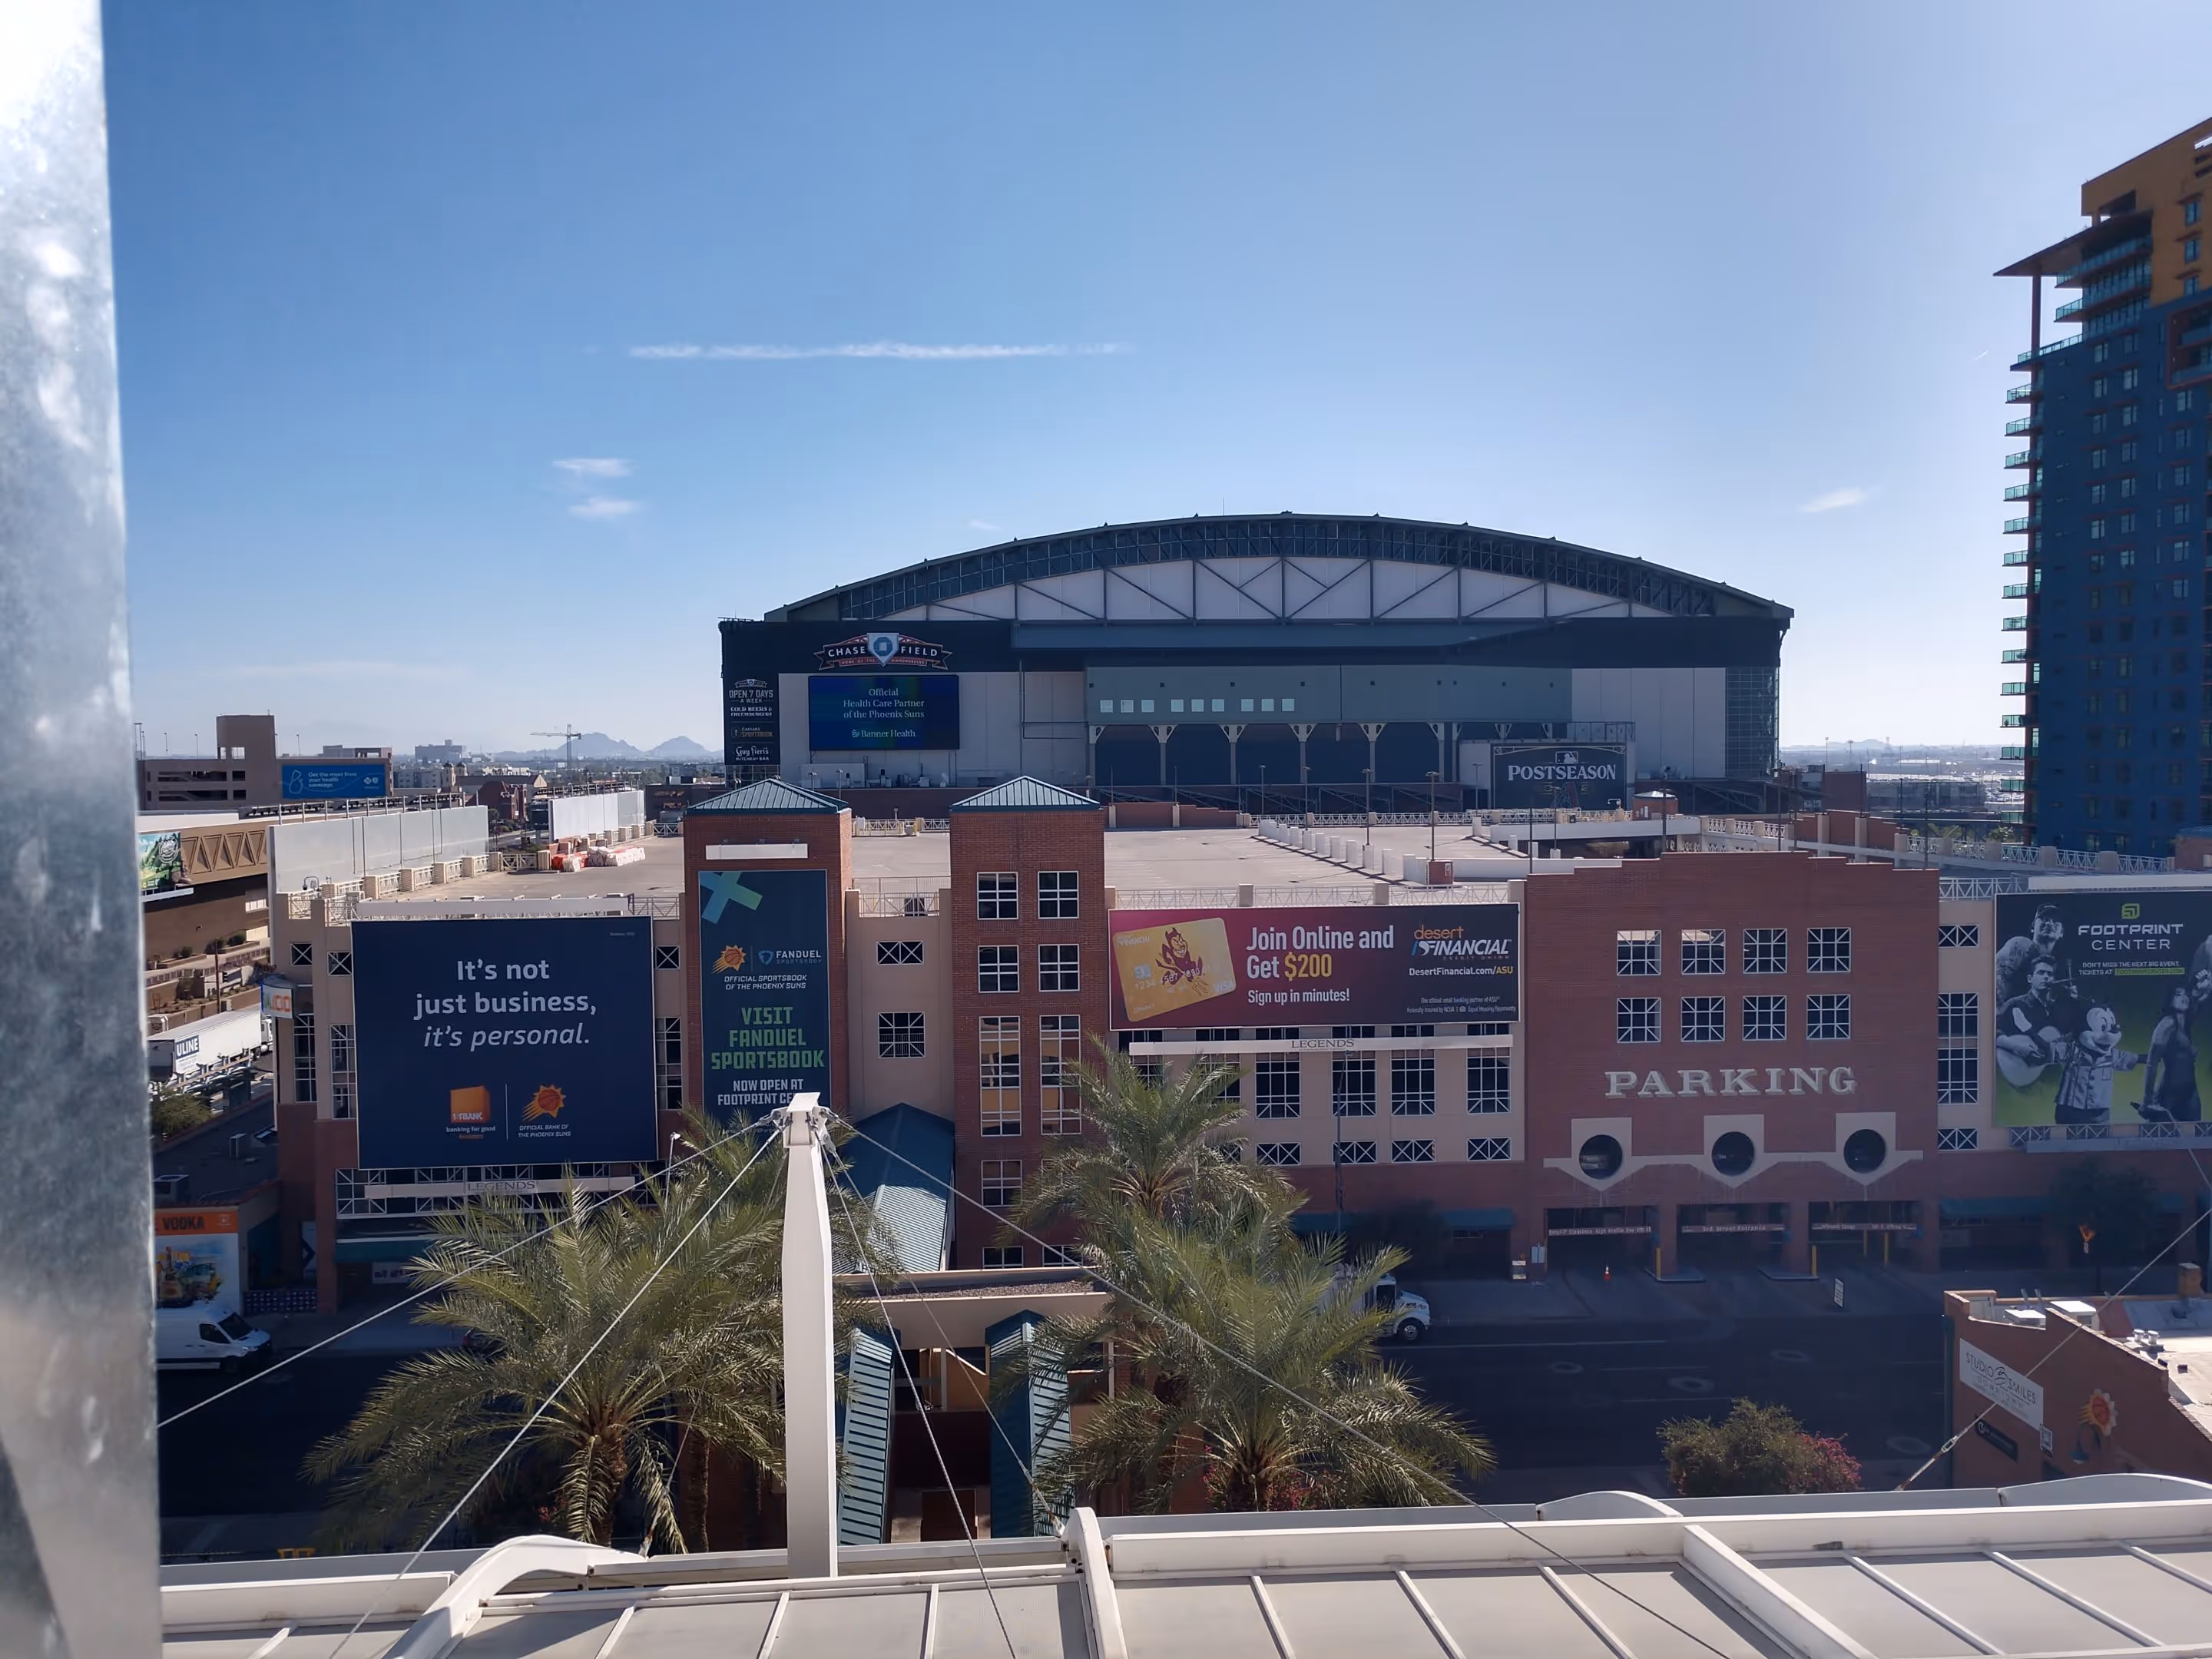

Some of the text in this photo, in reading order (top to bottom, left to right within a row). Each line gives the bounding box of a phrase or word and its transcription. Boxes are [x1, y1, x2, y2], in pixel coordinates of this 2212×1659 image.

[828, 646, 938, 657] CHASE FIELD
[729, 690, 747, 698] OPEN
[756, 690, 773, 698] DAYS
[843, 699, 871, 707] Health
[873, 699, 892, 707] Care
[843, 710, 925, 718] of the Phoenix Suns
[1508, 764, 1616, 781] POSTSEASON
[1413, 925, 1464, 940] desert
[2078, 923, 2184, 935] FOOTPRINT
[1246, 925, 1394, 951] Join Online and
[2091, 939, 2171, 951] CENTER
[776, 950, 822, 959] FANDUEL
[507, 960, 550, 980] not
[1247, 955, 1280, 979] Get
[1284, 952, 1333, 982] $200
[1409, 966, 1514, 976] DesertFinancial.com/ASU
[1248, 988, 1350, 1006] Sign up in minutes!
[413, 991, 597, 1021] just business,
[741, 1006, 793, 1025] VISIT
[470, 1023, 591, 1052] personal.
[730, 1028, 806, 1048] FANDUEL
[1292, 1039, 1355, 1048] LEGENDS
[176, 1038, 199, 1058] ULINE
[711, 1049, 825, 1070] SPORTSBOOK
[733, 1078, 804, 1091] NOW OPEN AT
[1604, 1066, 1856, 1098] PARKING
[717, 1094, 777, 1106] FOOTPRINT
[468, 1181, 535, 1191] LEGENDS
[161, 1217, 206, 1230] VODKA
[1966, 1352, 1995, 1378] STUDIO
[2008, 1378, 2036, 1405] SMILES
